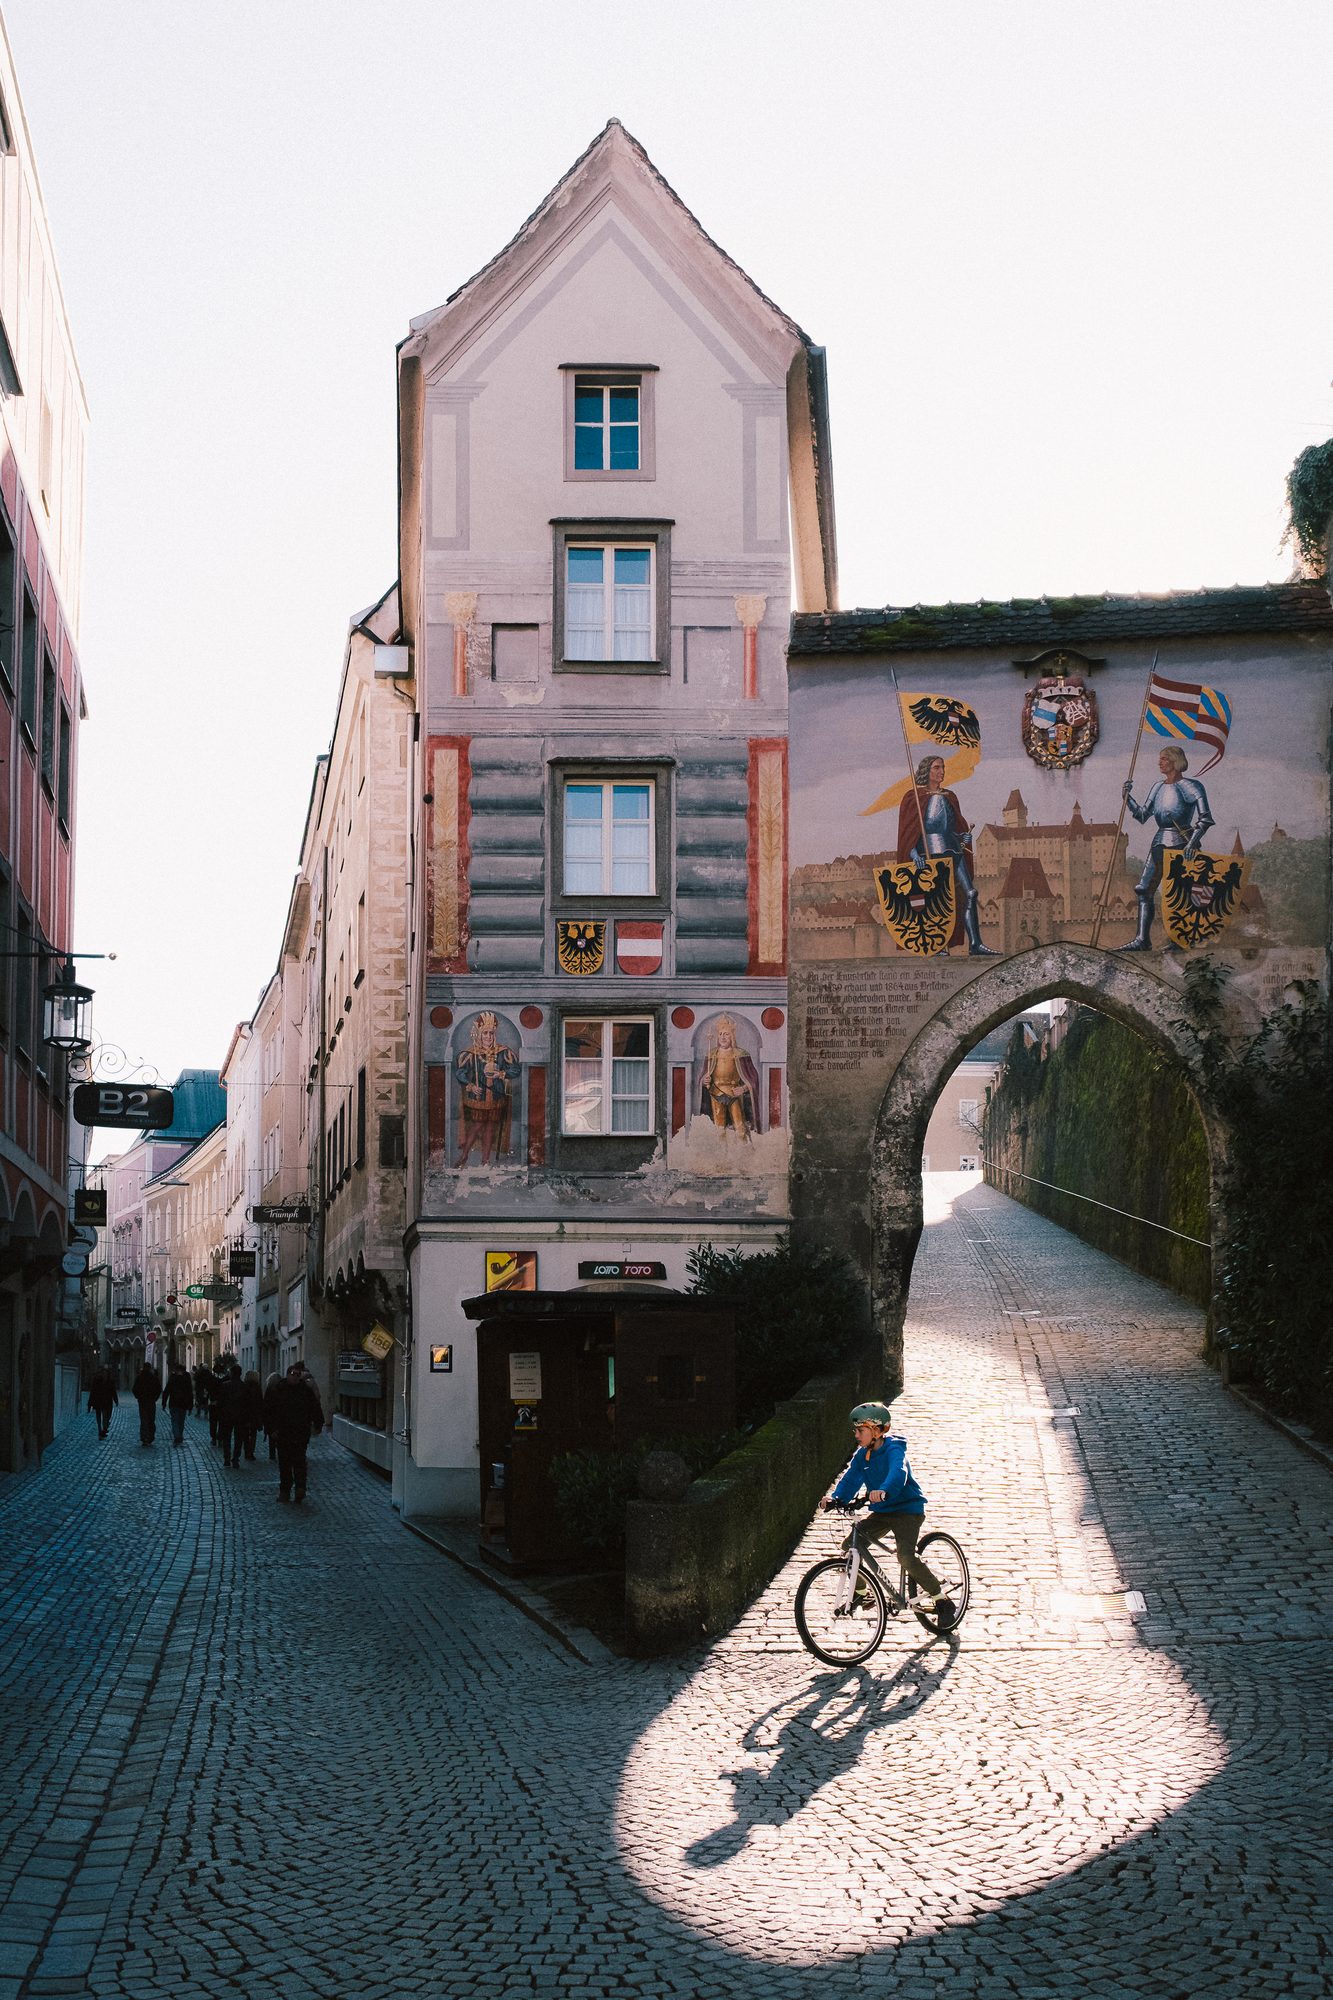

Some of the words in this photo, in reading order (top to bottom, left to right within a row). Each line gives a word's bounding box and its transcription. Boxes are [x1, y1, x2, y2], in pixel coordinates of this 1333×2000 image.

[869, 982, 883, 992] und
[886, 1017, 901, 1025] von
[98, 1088, 149, 1118] B2
[263, 1207, 300, 1222] Triumph
[230, 1256, 255, 1264] HUBER
[593, 1265, 620, 1275] LOTTO
[624, 1265, 652, 1275] TOTO
